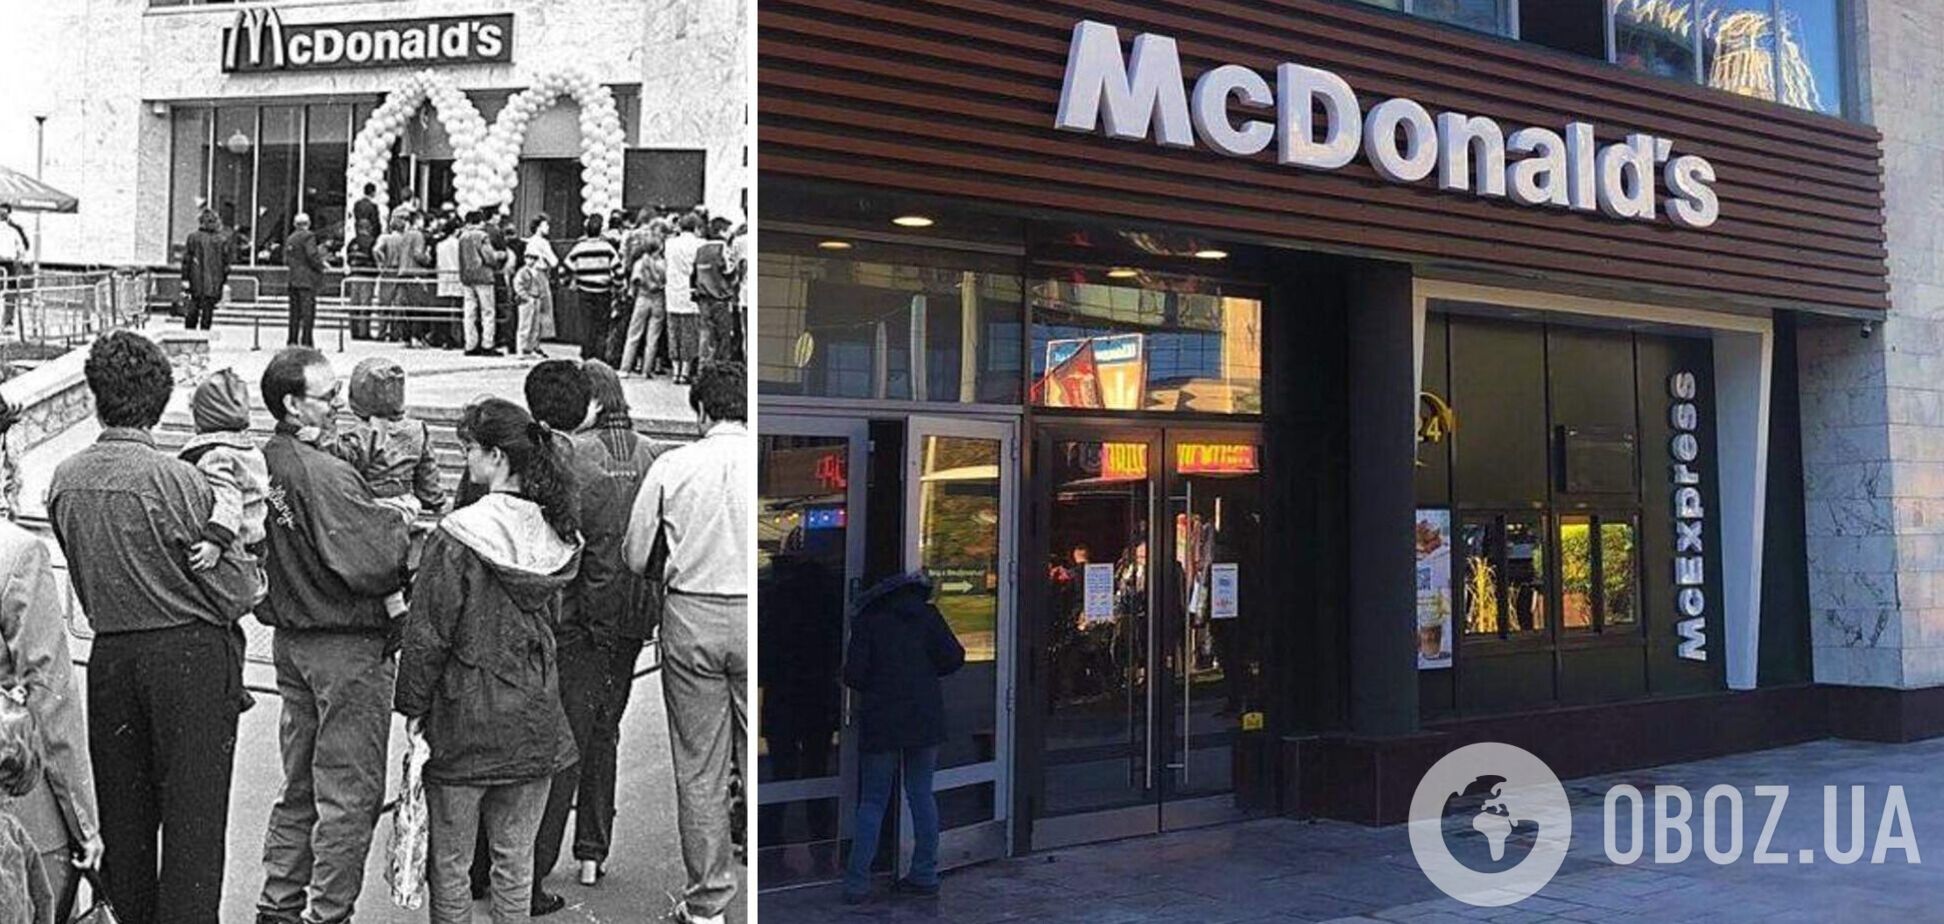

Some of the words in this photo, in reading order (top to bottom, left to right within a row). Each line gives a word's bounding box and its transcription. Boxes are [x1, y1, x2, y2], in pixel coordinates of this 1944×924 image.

[225, 7, 503, 69] McDonald's
[1053, 19, 1720, 229] McDonald's
[1669, 371, 1707, 662] McExpress
